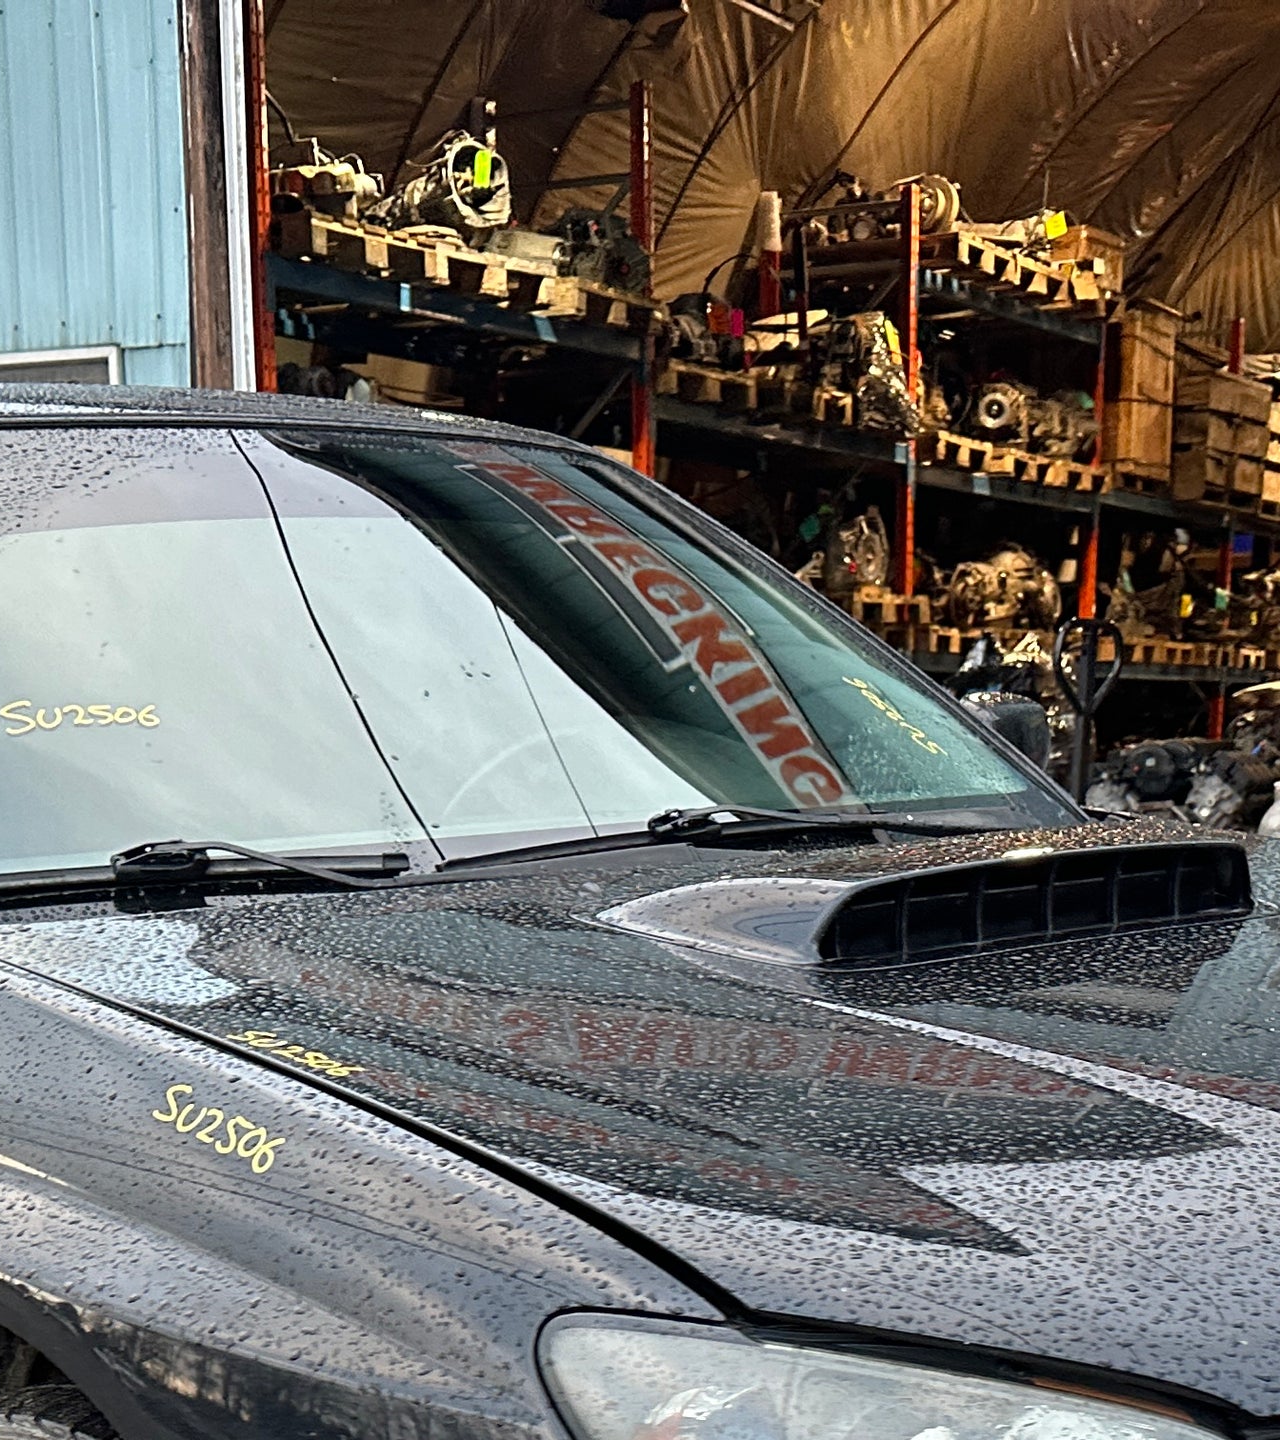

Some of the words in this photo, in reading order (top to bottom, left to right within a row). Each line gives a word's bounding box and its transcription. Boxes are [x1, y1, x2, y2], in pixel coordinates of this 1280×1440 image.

[0, 700, 161, 736] SU2506
[226, 1030, 365, 1078] SU2506
[152, 1084, 286, 1174] SU2506
